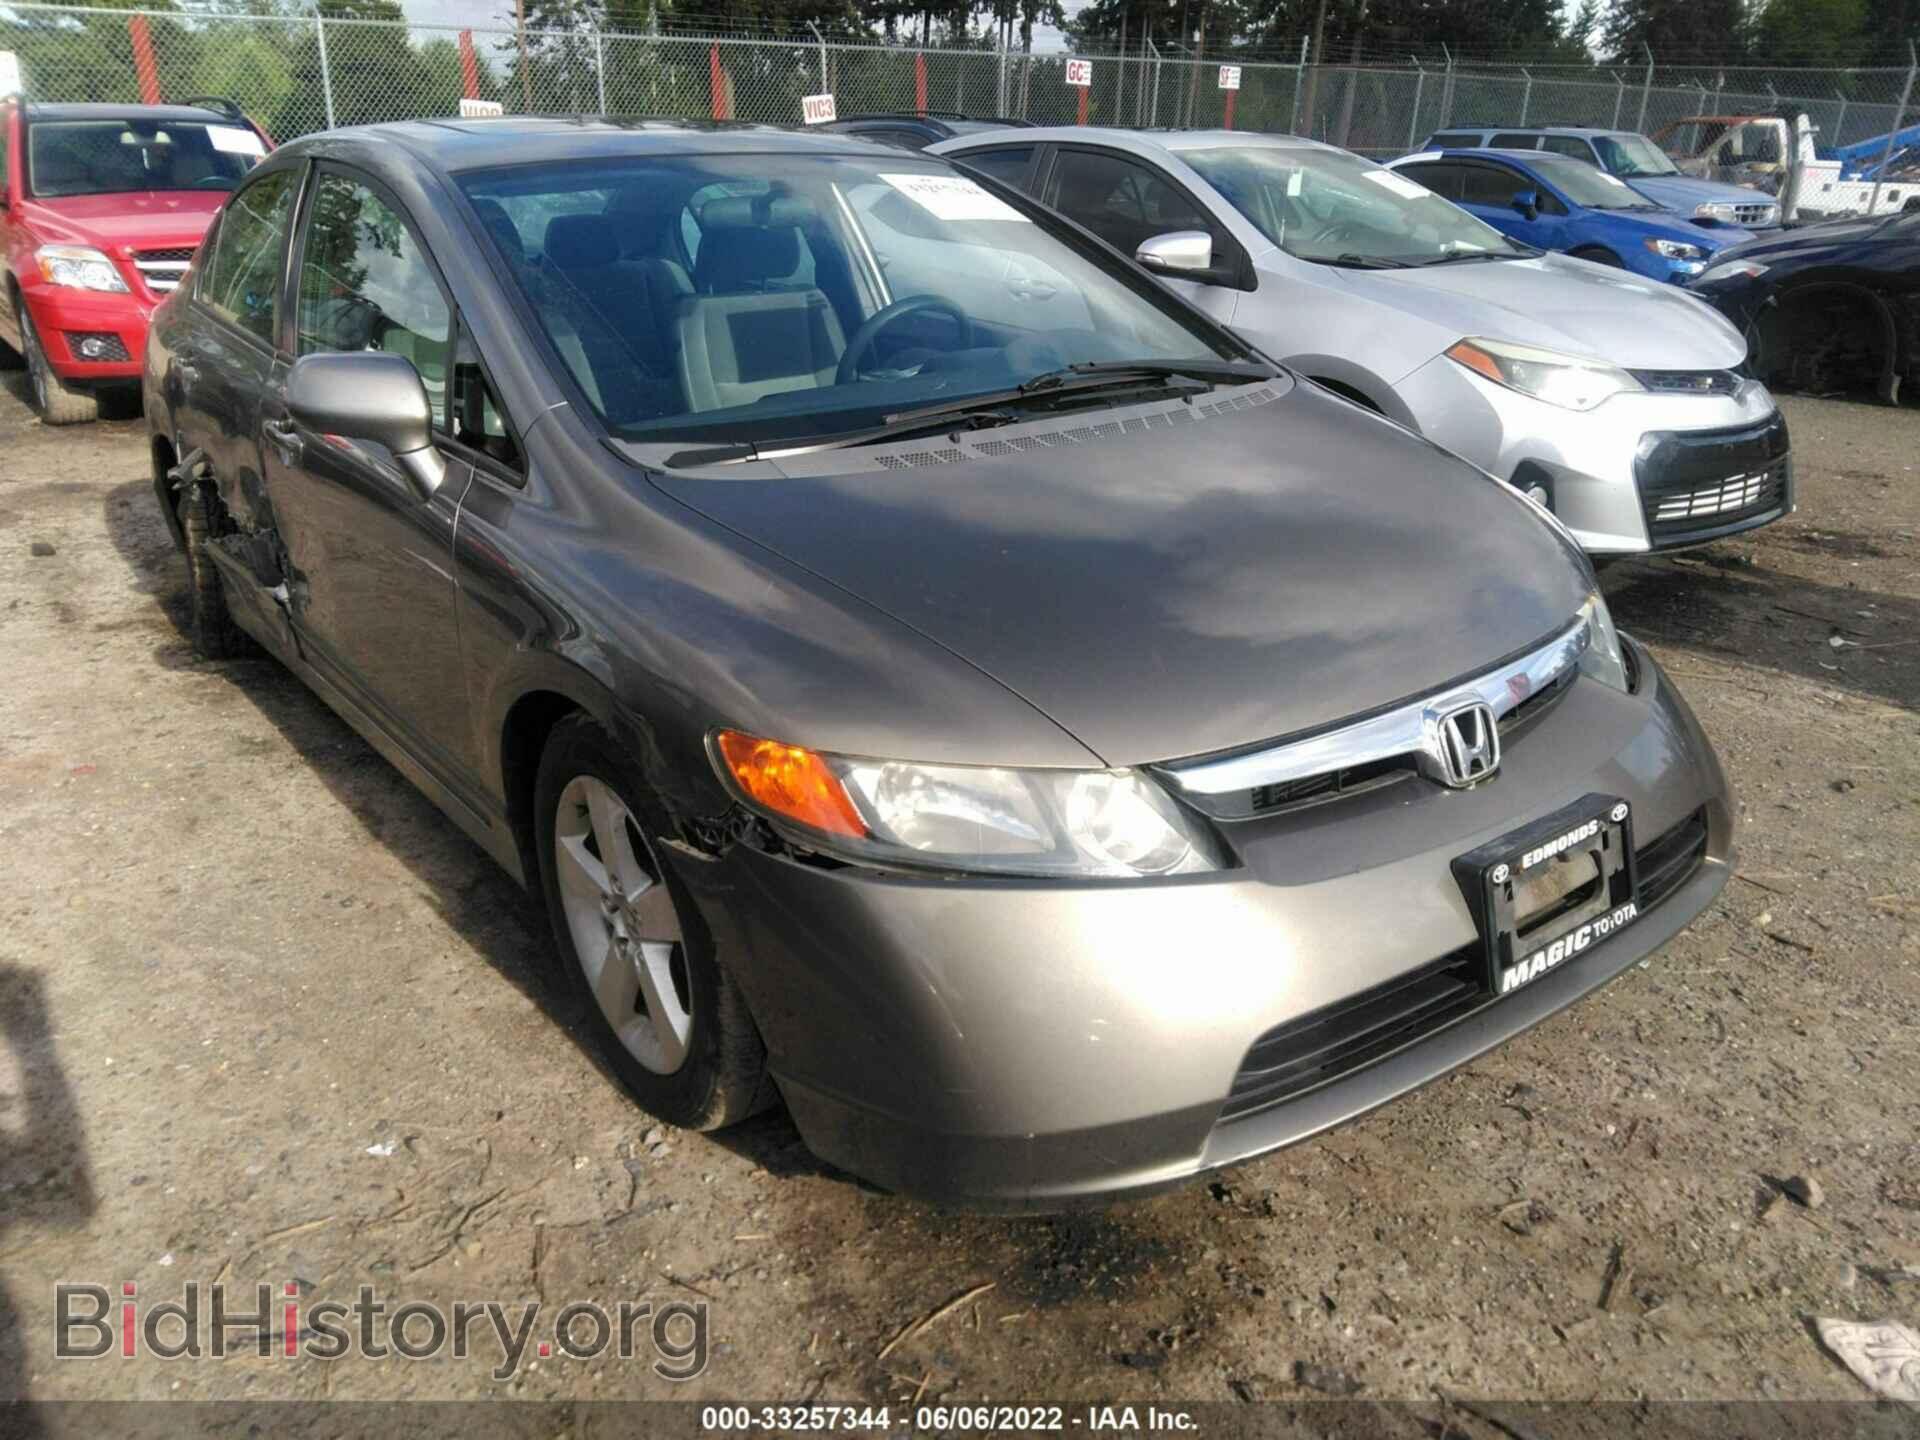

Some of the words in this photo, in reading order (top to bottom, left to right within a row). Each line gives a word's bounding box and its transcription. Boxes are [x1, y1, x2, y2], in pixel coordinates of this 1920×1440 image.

[804, 99, 833, 118] VIC3
[1522, 819, 1598, 869] EDMONDS
[1503, 925, 1592, 993] MAGIC
